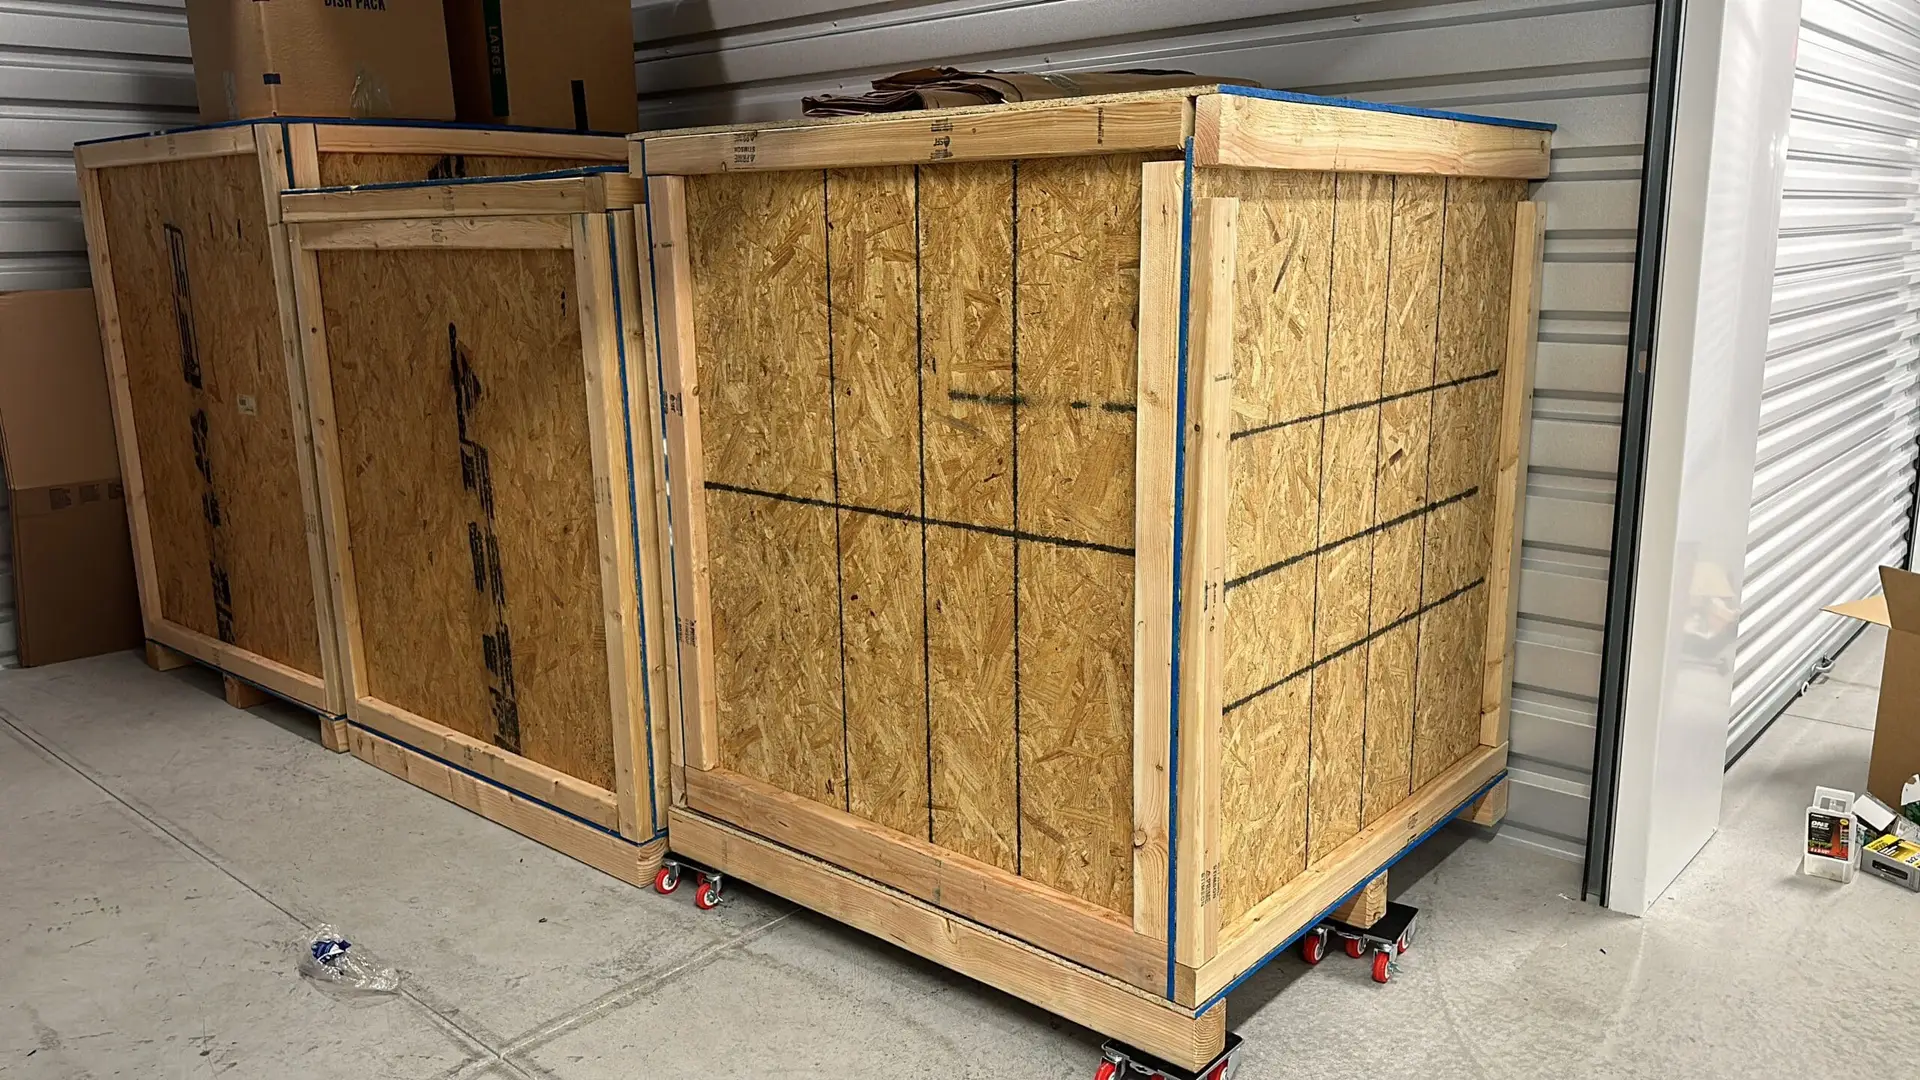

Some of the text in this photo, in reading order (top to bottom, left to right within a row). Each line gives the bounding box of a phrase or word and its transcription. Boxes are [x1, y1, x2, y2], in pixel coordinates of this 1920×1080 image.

[324, 0, 386, 11] DISH PACK
[488, 26, 501, 75] LARGE
